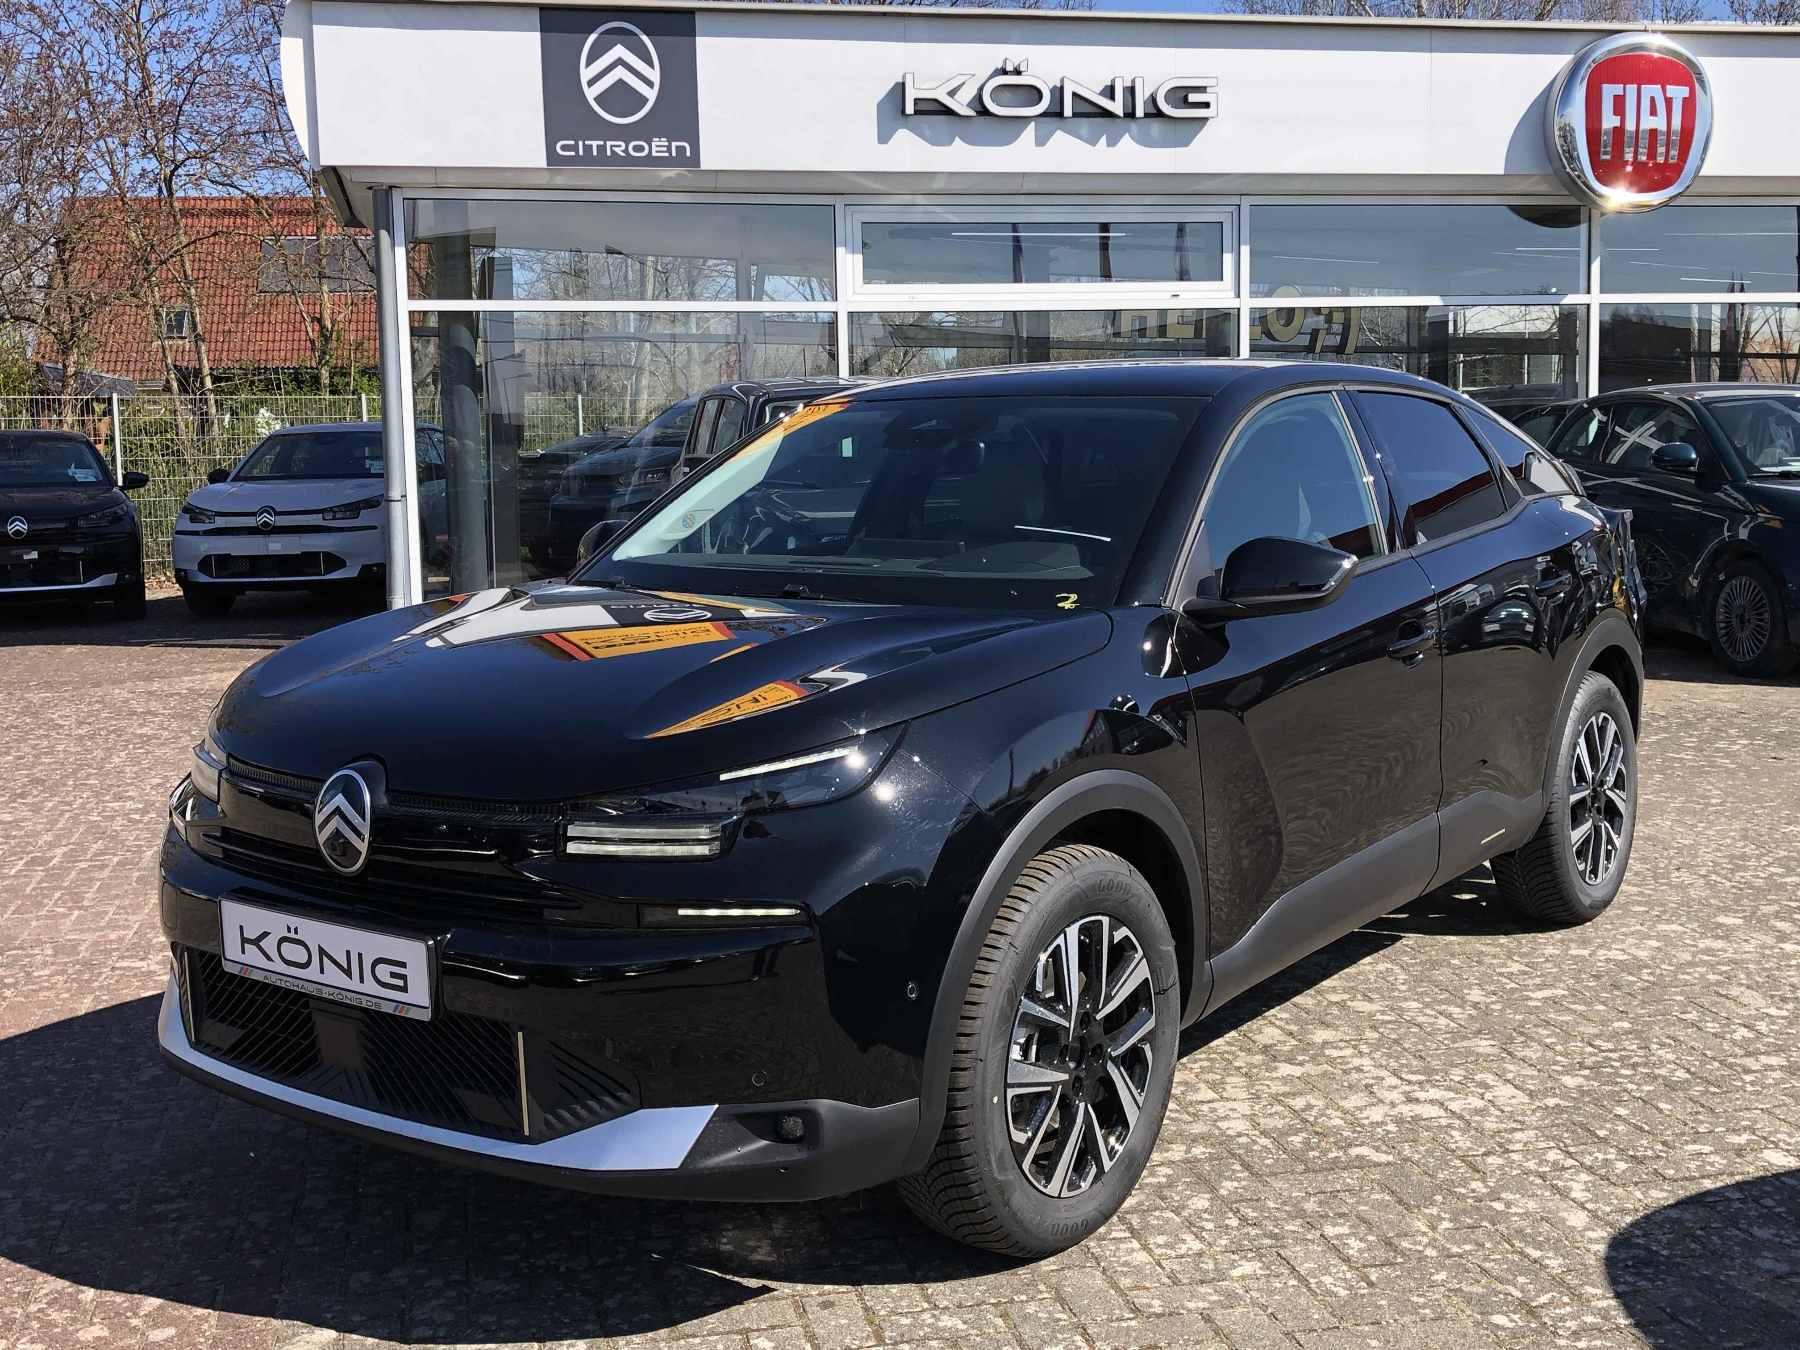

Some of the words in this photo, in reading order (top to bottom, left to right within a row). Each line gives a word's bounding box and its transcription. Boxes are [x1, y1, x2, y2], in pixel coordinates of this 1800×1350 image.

[902, 57, 1219, 118] KÖNIG
[1600, 83, 1690, 164] FIAT
[239, 923, 409, 994] KÖNIG
